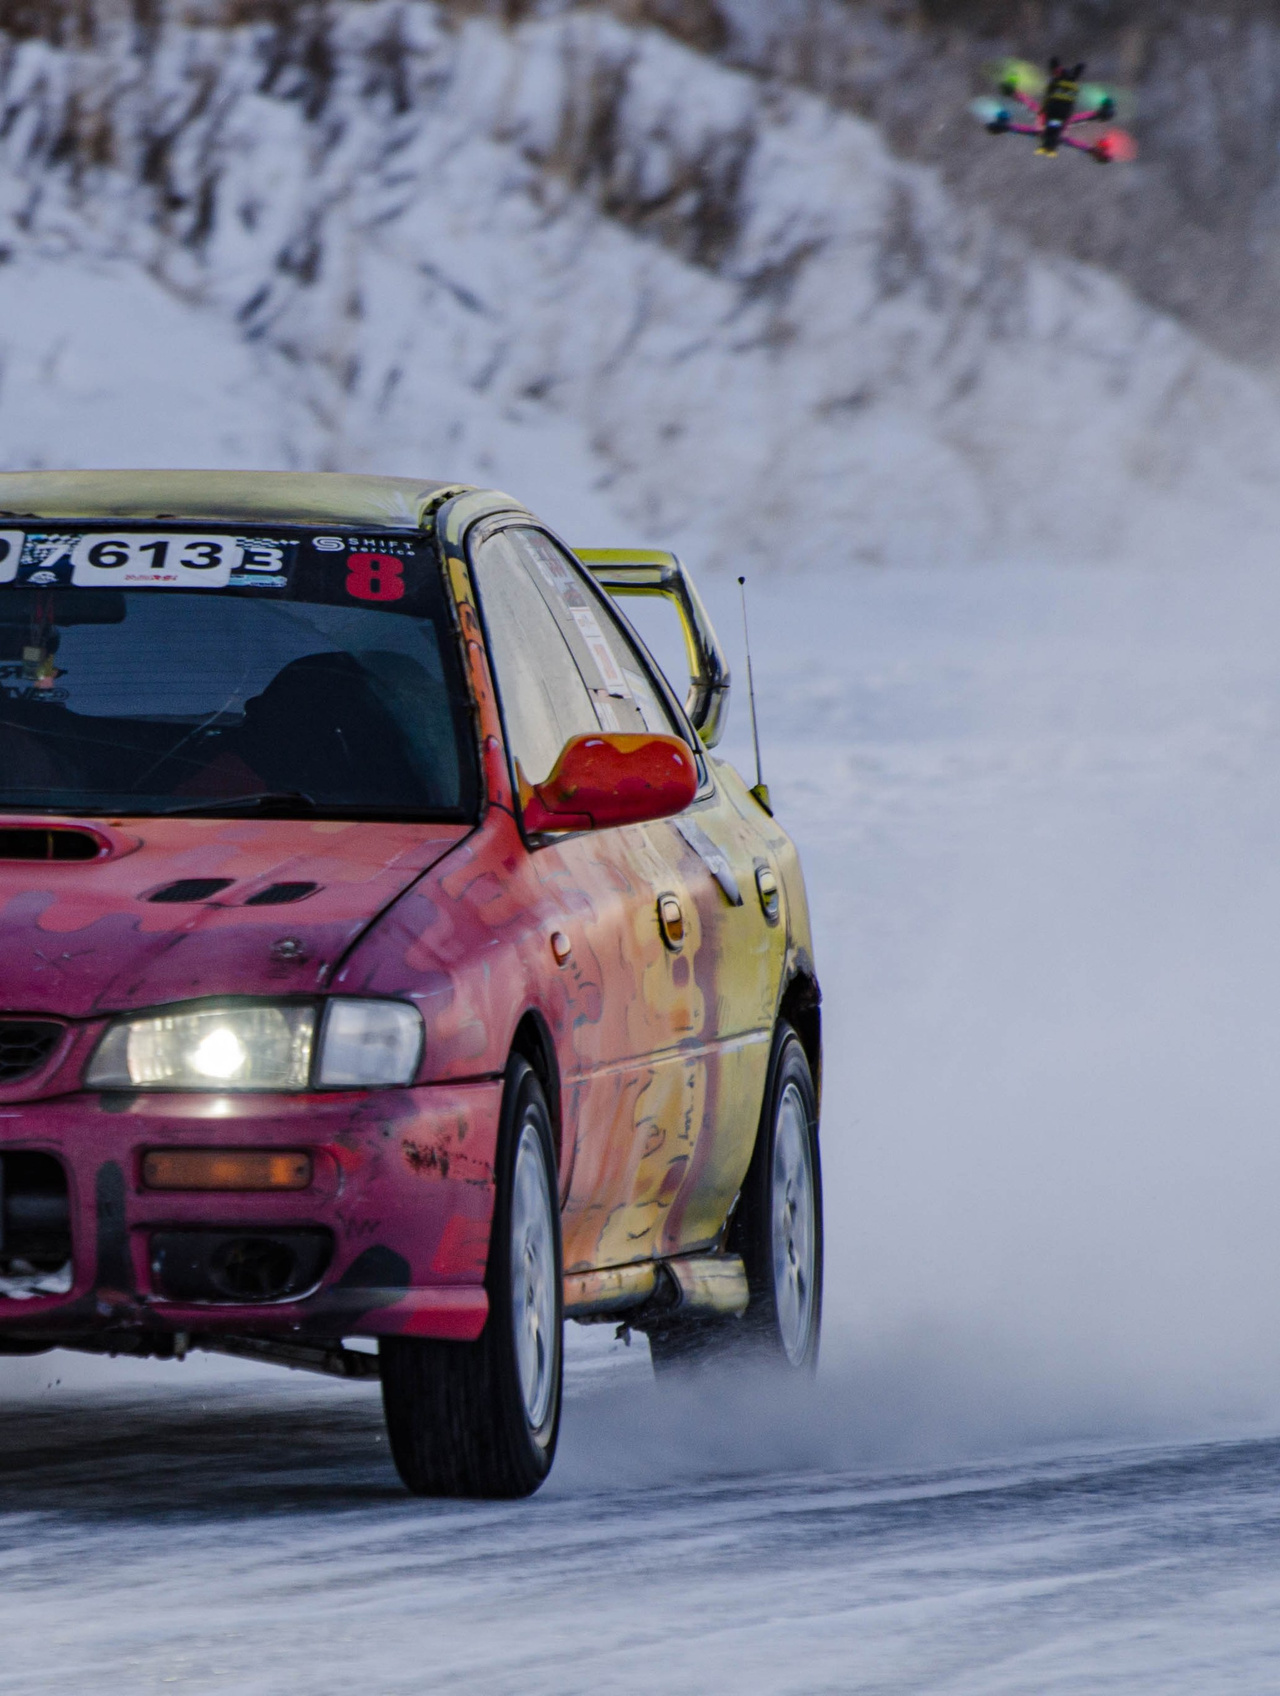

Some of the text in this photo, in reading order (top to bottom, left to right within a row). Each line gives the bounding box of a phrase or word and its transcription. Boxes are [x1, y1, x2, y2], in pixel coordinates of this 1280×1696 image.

[87, 540, 224, 570] 613
[347, 537, 413, 550] SHIFT
[345, 552, 406, 601] 8
